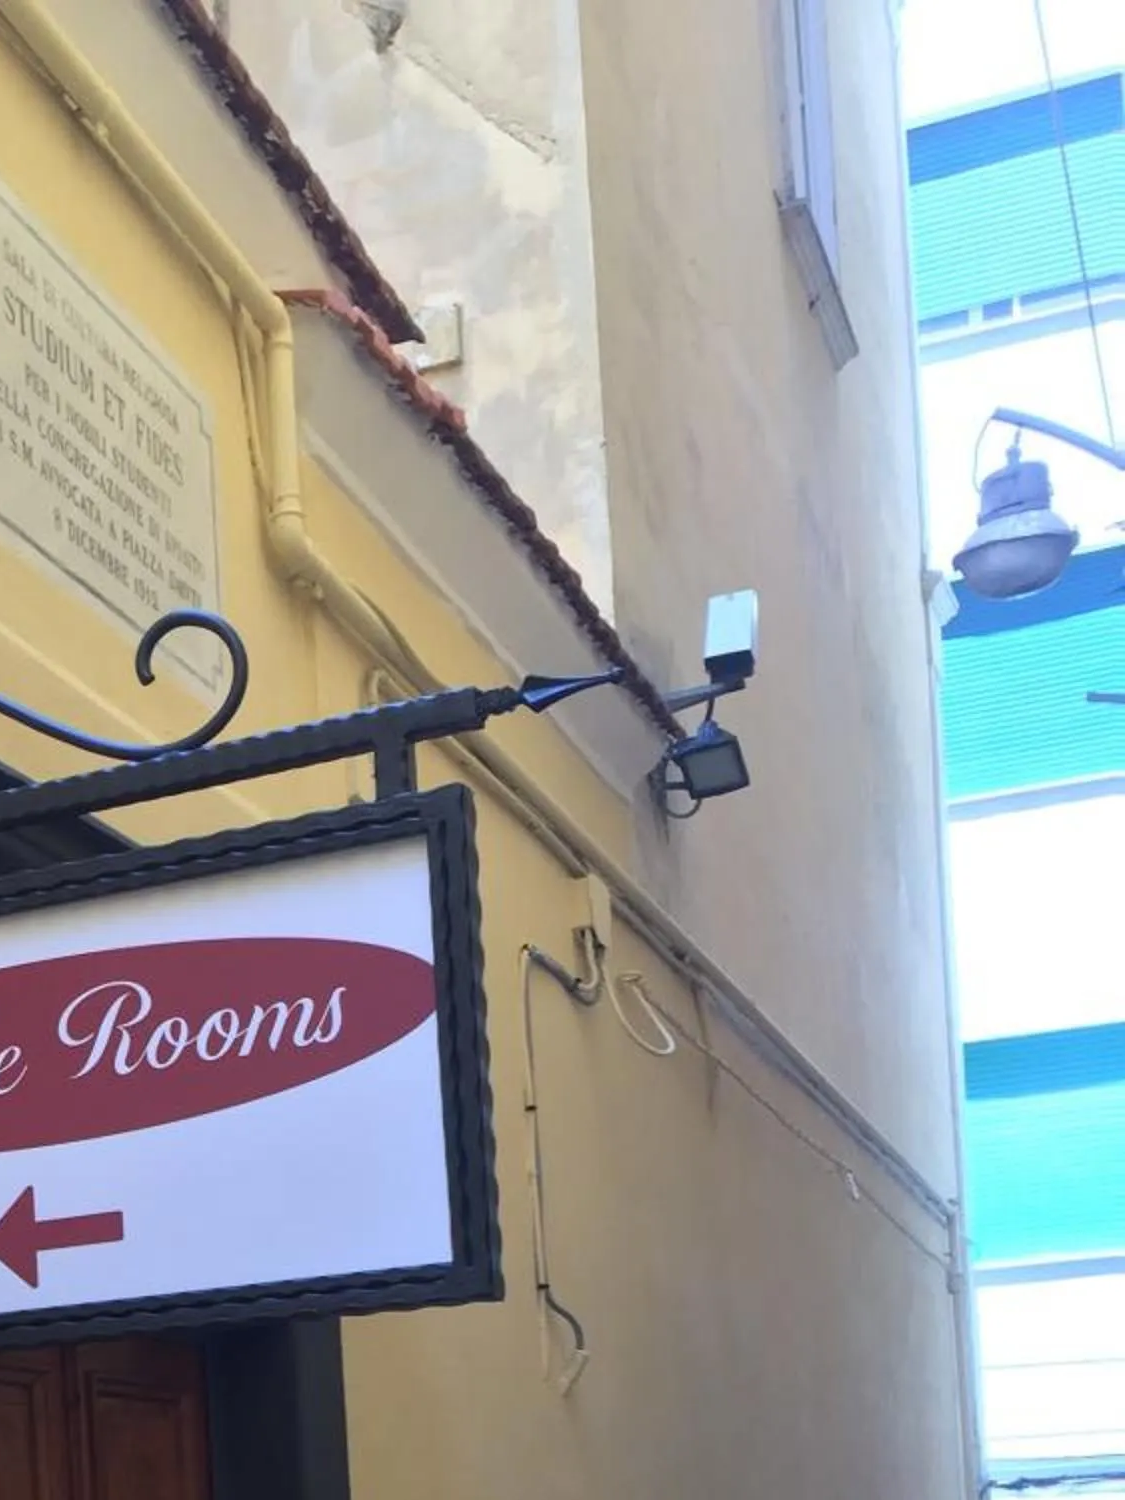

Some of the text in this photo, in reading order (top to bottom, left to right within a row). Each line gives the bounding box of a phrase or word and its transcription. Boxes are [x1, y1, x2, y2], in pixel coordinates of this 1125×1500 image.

[2, 285, 185, 488] STUDIUM ET FIDES
[24, 362, 51, 403] PER
[37, 415, 144, 529] CONGREGAZIONE
[66, 518, 130, 588] DICEMBRE
[122, 527, 164, 581] PIAZZA
[58, 981, 347, 1080] Rooms
